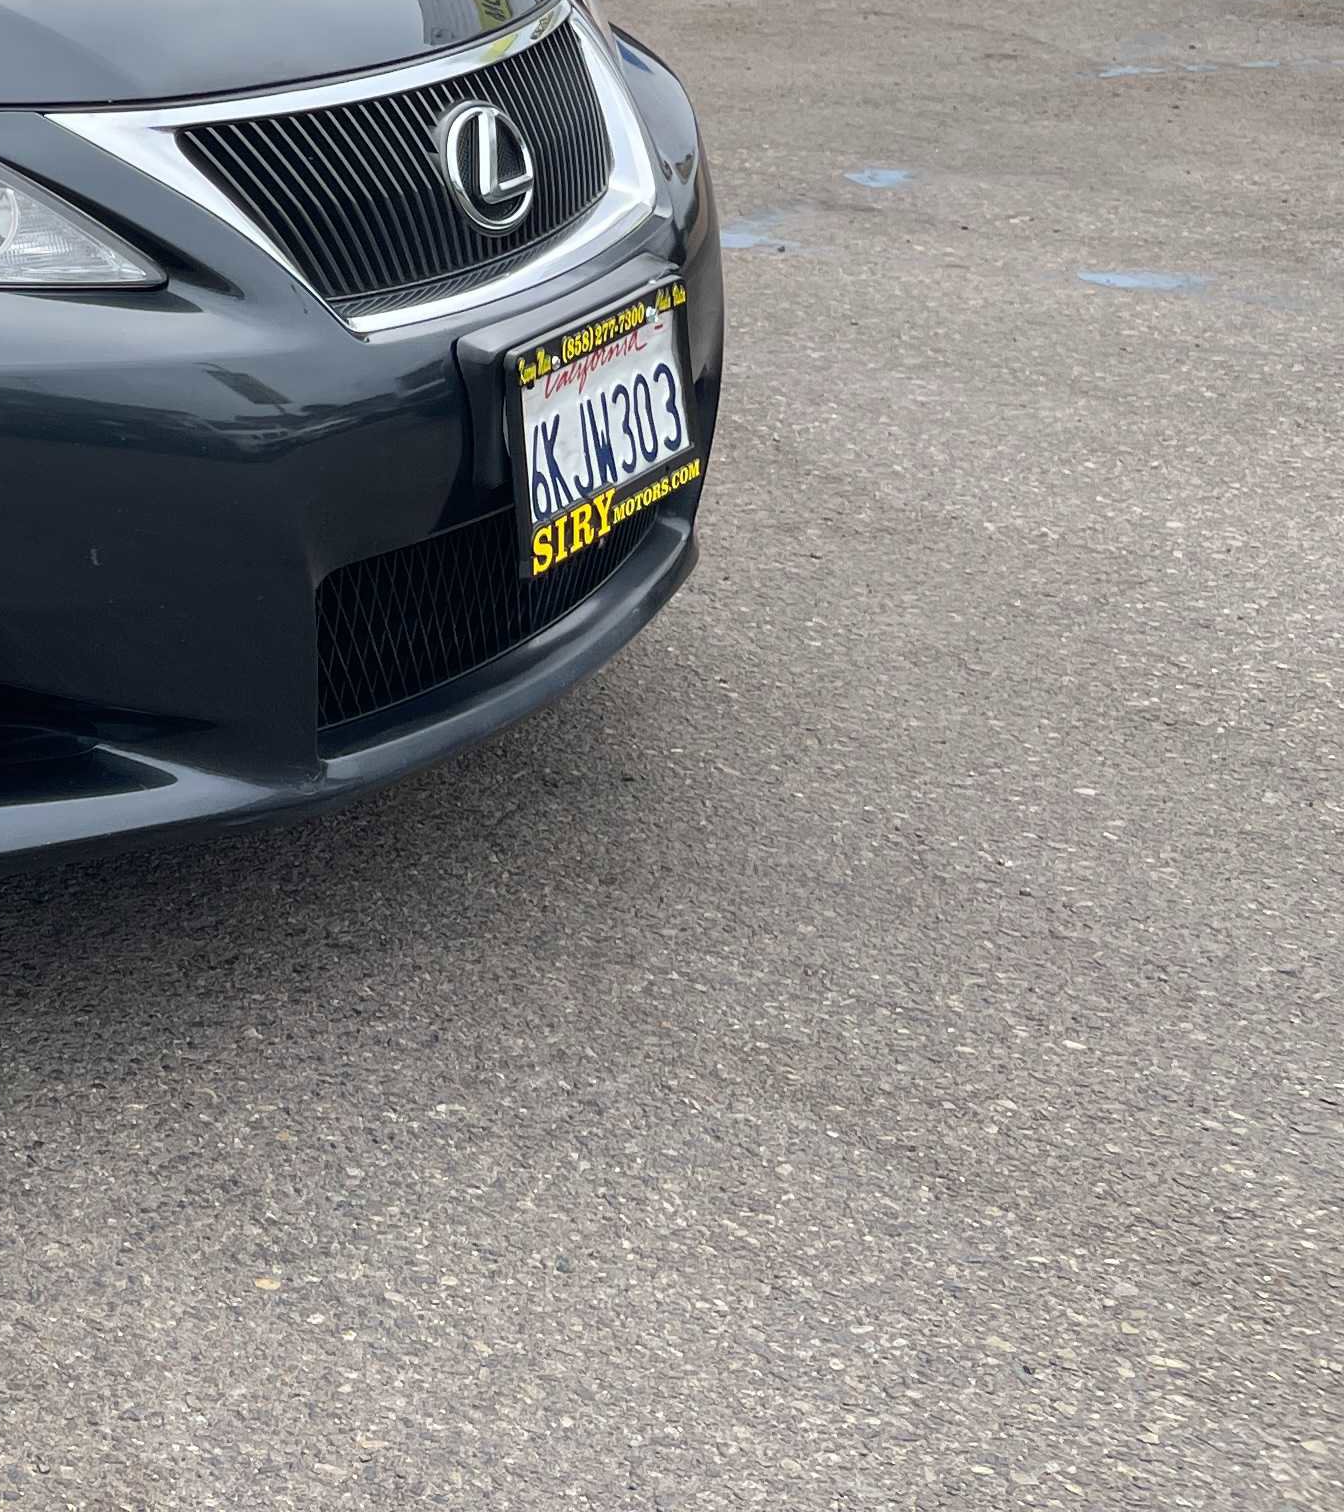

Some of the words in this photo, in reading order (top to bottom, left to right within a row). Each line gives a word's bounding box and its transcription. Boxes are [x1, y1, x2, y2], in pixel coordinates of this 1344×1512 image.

[530, 362, 683, 522] 6KJW303
[531, 487, 617, 576] SIRY
[612, 458, 701, 524] MOTORS.COM
